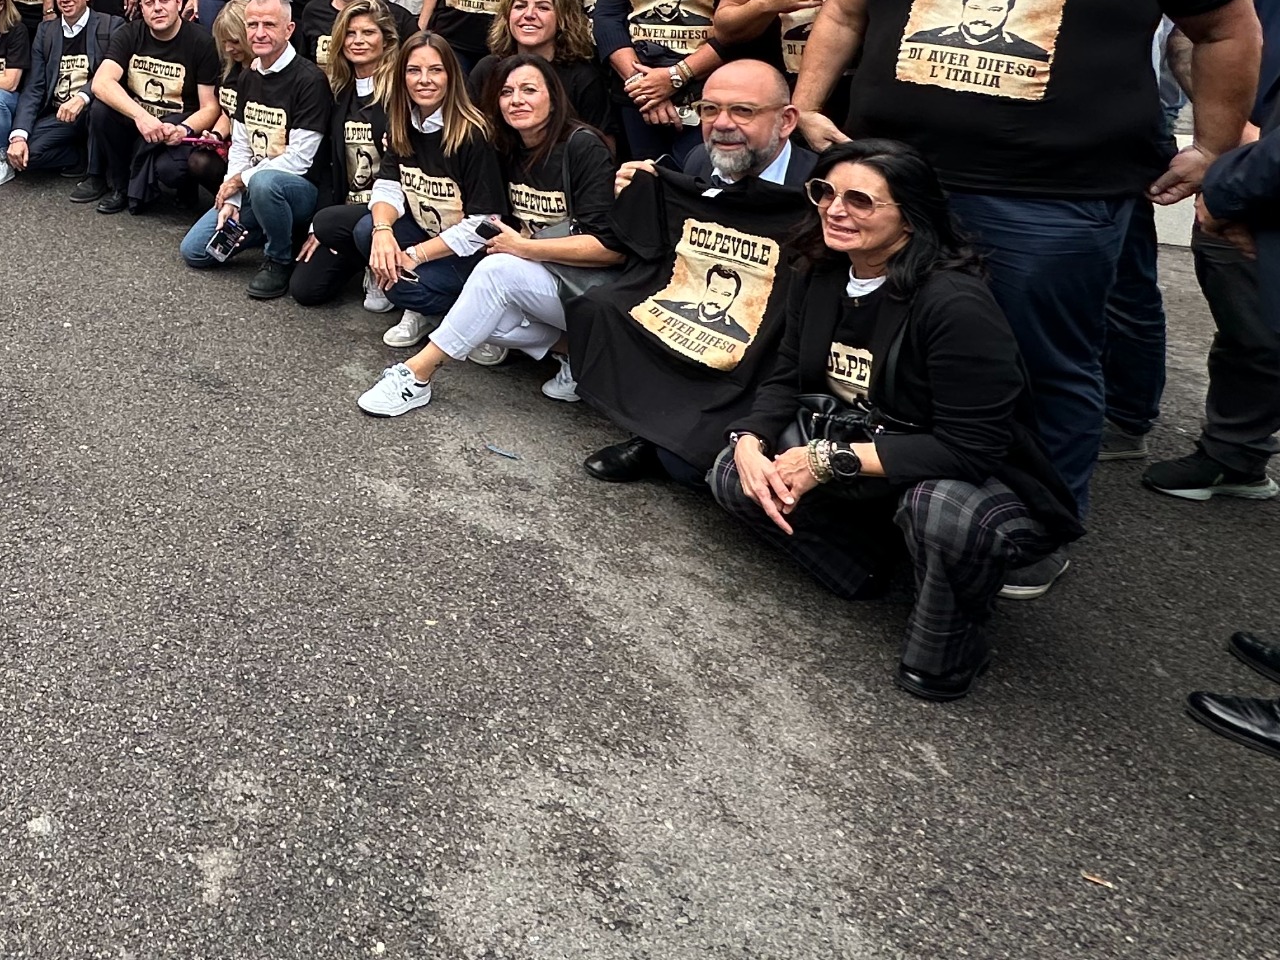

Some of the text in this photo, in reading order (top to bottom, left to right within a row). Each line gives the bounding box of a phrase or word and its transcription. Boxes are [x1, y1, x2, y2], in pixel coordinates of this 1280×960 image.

[642, 27, 667, 38] AVER
[670, 29, 708, 40] DIFESO
[787, 43, 797, 55] DI
[133, 58, 181, 78] COLPEVOLE
[908, 47, 1038, 78] DI AVER DIFESO
[929, 64, 1001, 89] L'ITALIA
[511, 188, 567, 214] COLPEVOLE
[689, 226, 772, 266] COLPEVOLE
[648, 306, 737, 354] DI AVER DIFESO
[658, 324, 709, 356] L'ITALIA
